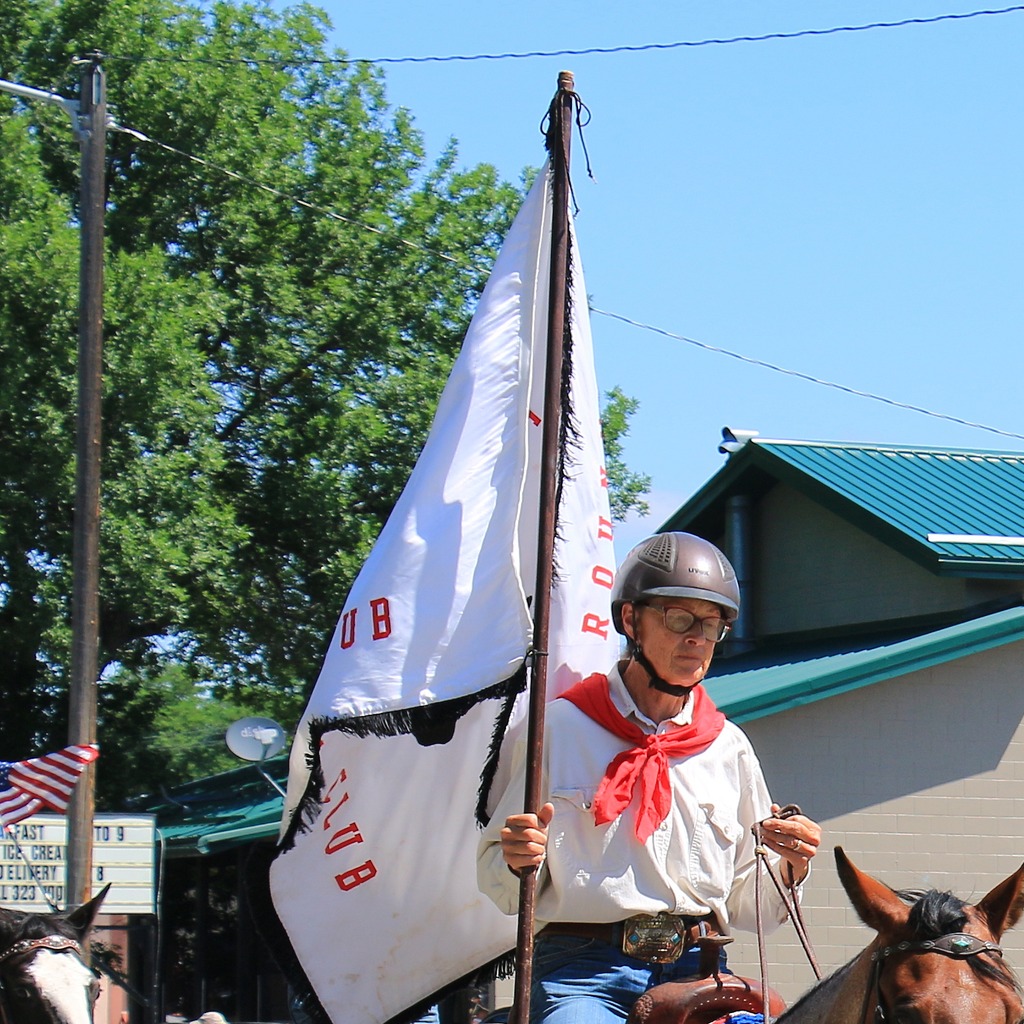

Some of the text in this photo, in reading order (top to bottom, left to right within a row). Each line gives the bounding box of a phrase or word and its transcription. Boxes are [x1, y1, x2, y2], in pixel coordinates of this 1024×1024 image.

[240, 724, 262, 738] dis
[94, 826, 109, 841] TO
[117, 826, 124, 841] 9
[3, 845, 22, 860] ICE
[96, 866, 104, 881] 8
[12, 885, 35, 900] 323
